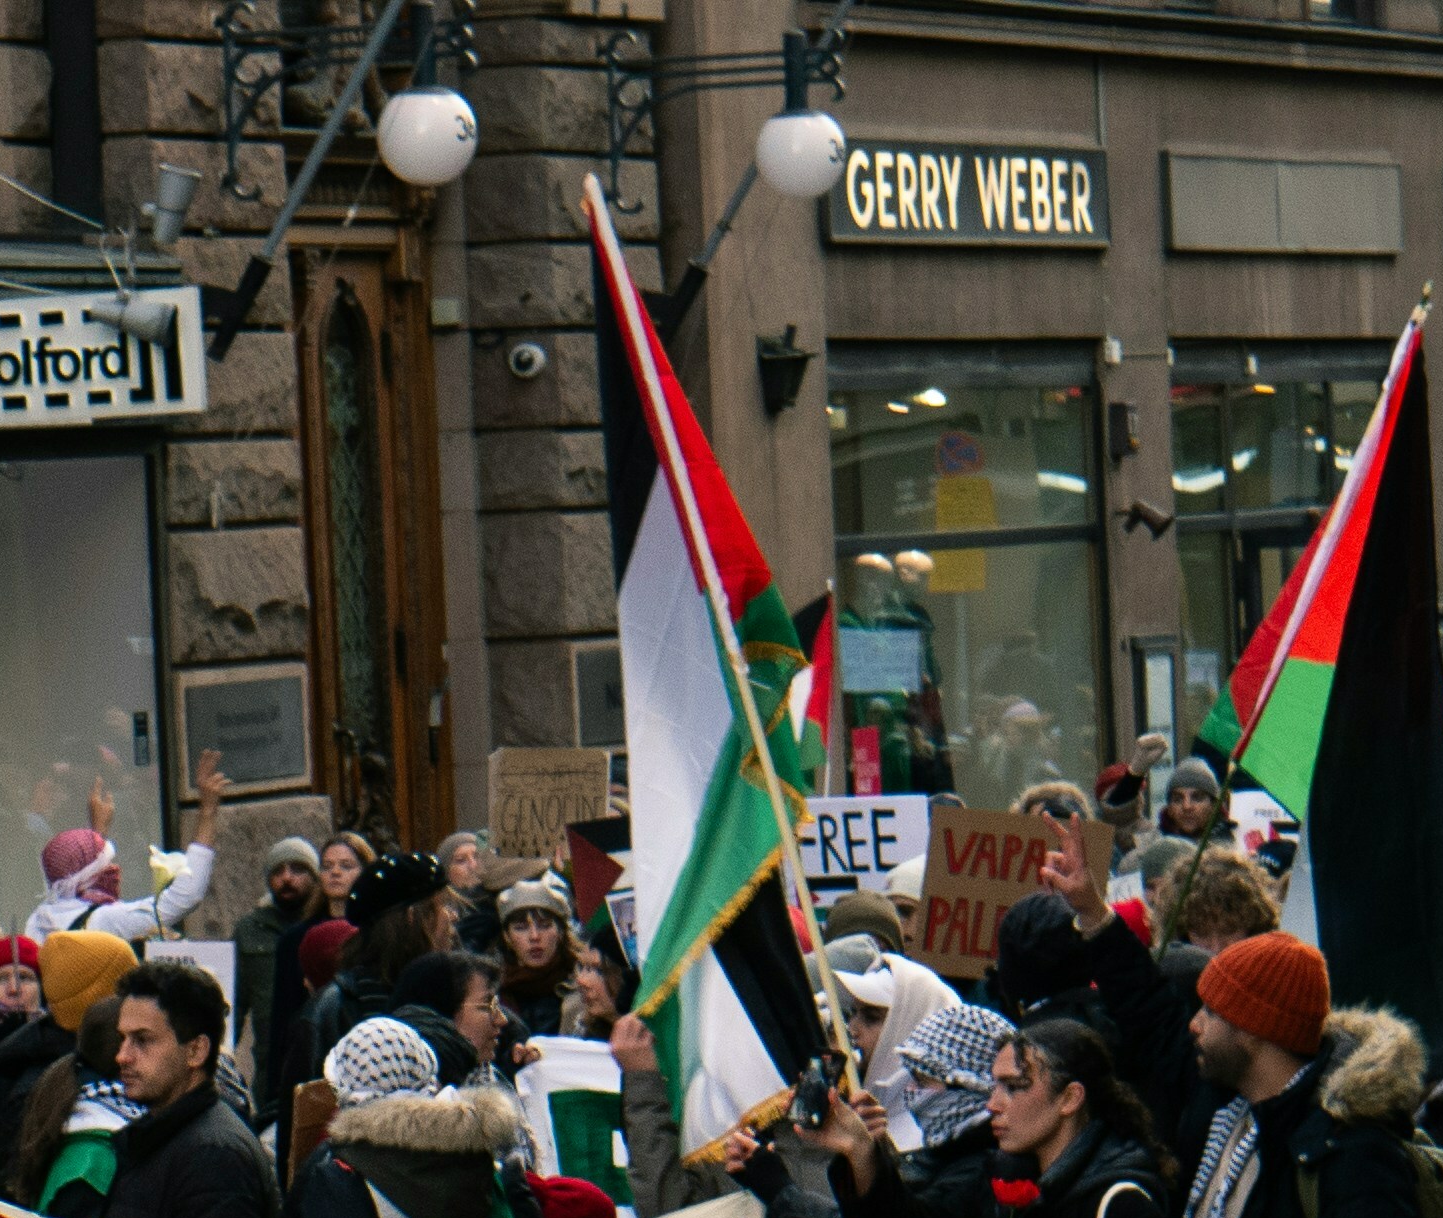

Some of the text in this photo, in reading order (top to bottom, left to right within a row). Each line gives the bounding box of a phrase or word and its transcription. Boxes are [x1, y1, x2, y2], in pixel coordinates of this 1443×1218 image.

[845, 149, 1094, 234] GERRY WEBER
[943, 827, 1046, 886] VAPA
